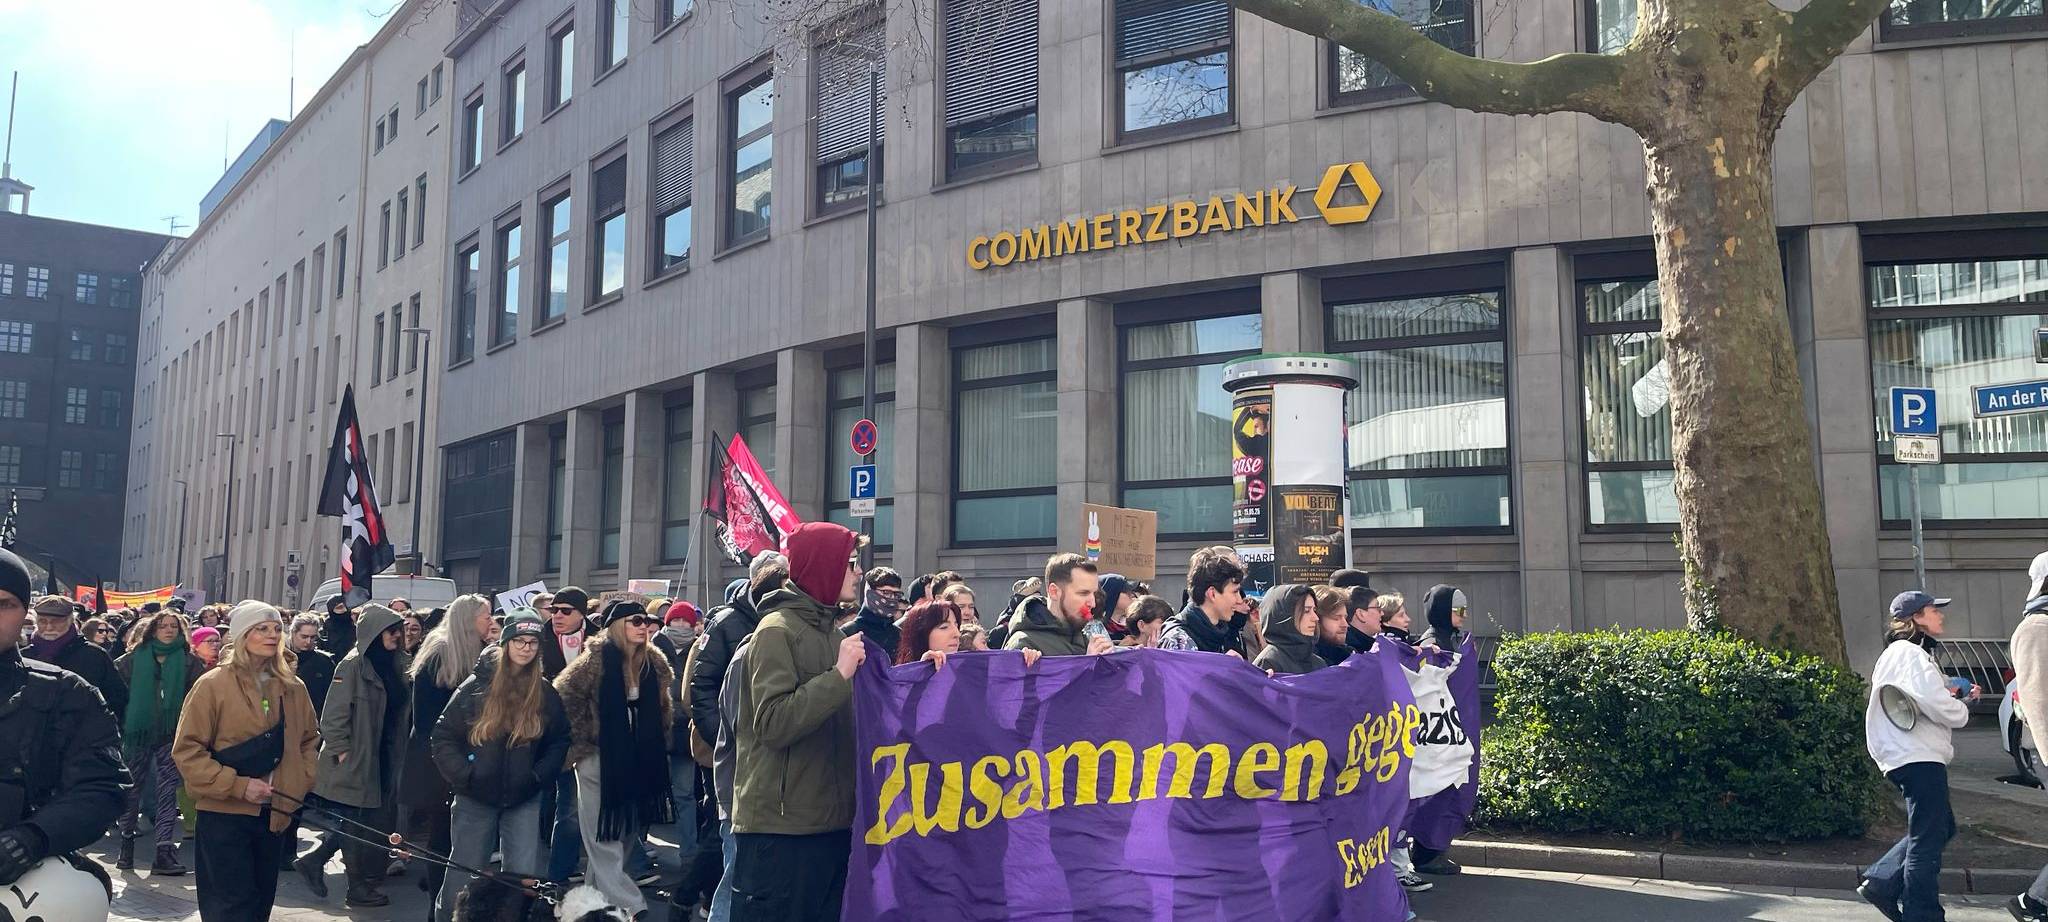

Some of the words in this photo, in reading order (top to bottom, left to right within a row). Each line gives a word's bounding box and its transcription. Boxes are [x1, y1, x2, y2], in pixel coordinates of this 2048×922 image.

[967, 184, 1299, 271] COMMERZBANK
[1902, 394, 1926, 428] P
[1988, 393, 2007, 409] An
[2012, 390, 2036, 406] der
[1899, 450, 1935, 460] Parkschein
[856, 470, 871, 497] P
[1284, 494, 1337, 511] VOLBEAT
[1298, 546, 1329, 556] BUSH
[864, 739, 1329, 845] Zusammen
[1335, 700, 1420, 796] gege
[1417, 698, 1467, 746] azis
